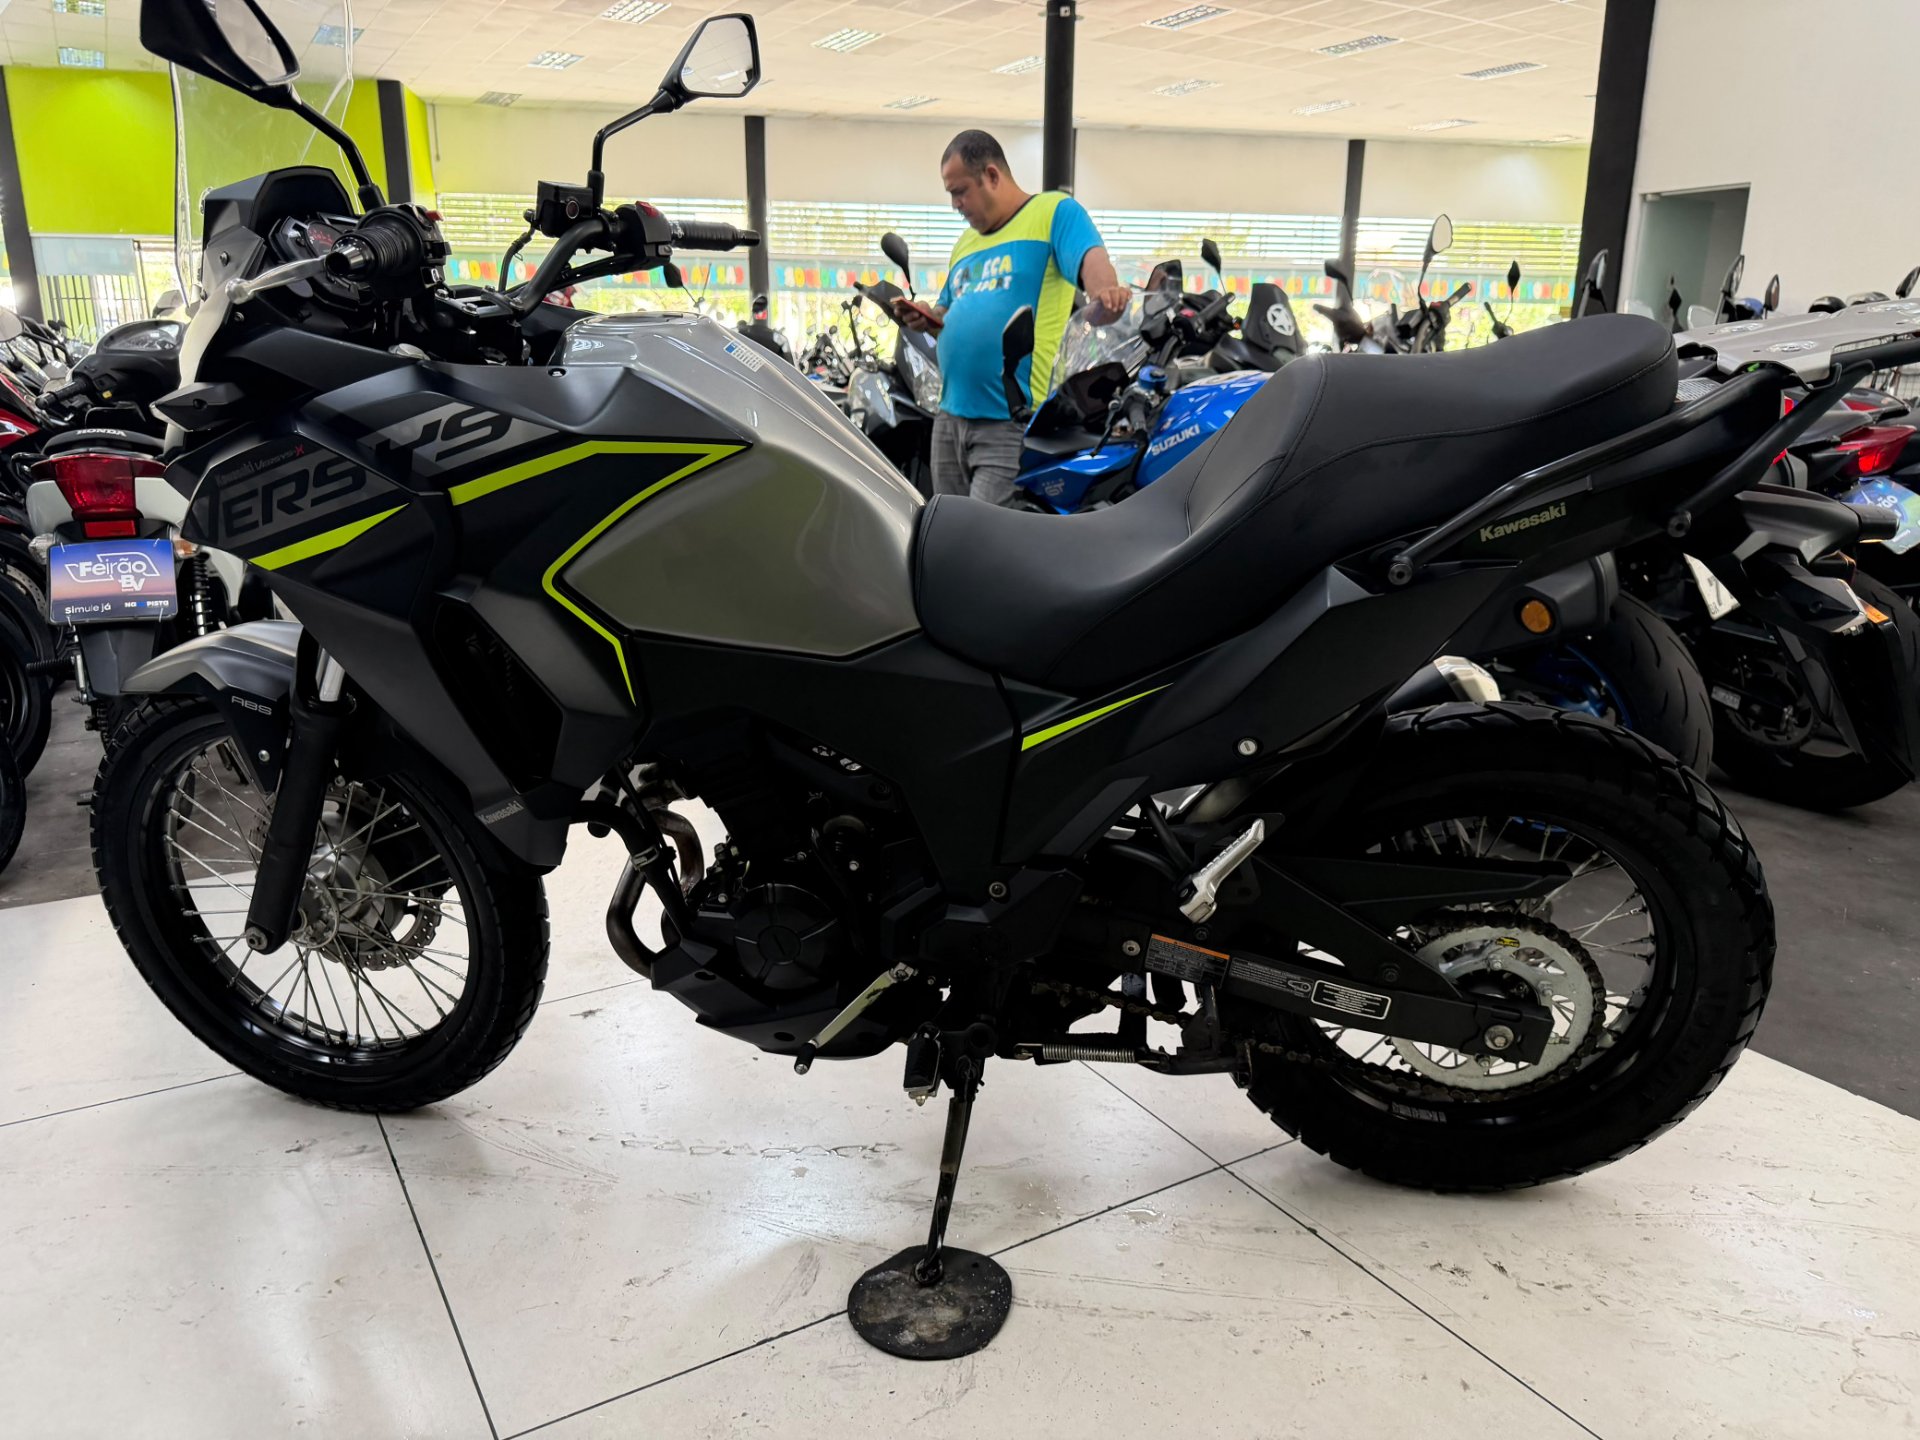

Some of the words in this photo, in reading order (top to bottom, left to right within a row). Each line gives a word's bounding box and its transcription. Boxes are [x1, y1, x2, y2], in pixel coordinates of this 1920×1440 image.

[77, 428, 127, 437] HONDA
[1151, 424, 1200, 456] SUZUKI
[1480, 502, 1567, 542] Kawasaki
[79, 558, 147, 577] Feirão
[120, 574, 145, 592] BV
[231, 695, 273, 716] ABS
[478, 800, 525, 825] Kawasaki
